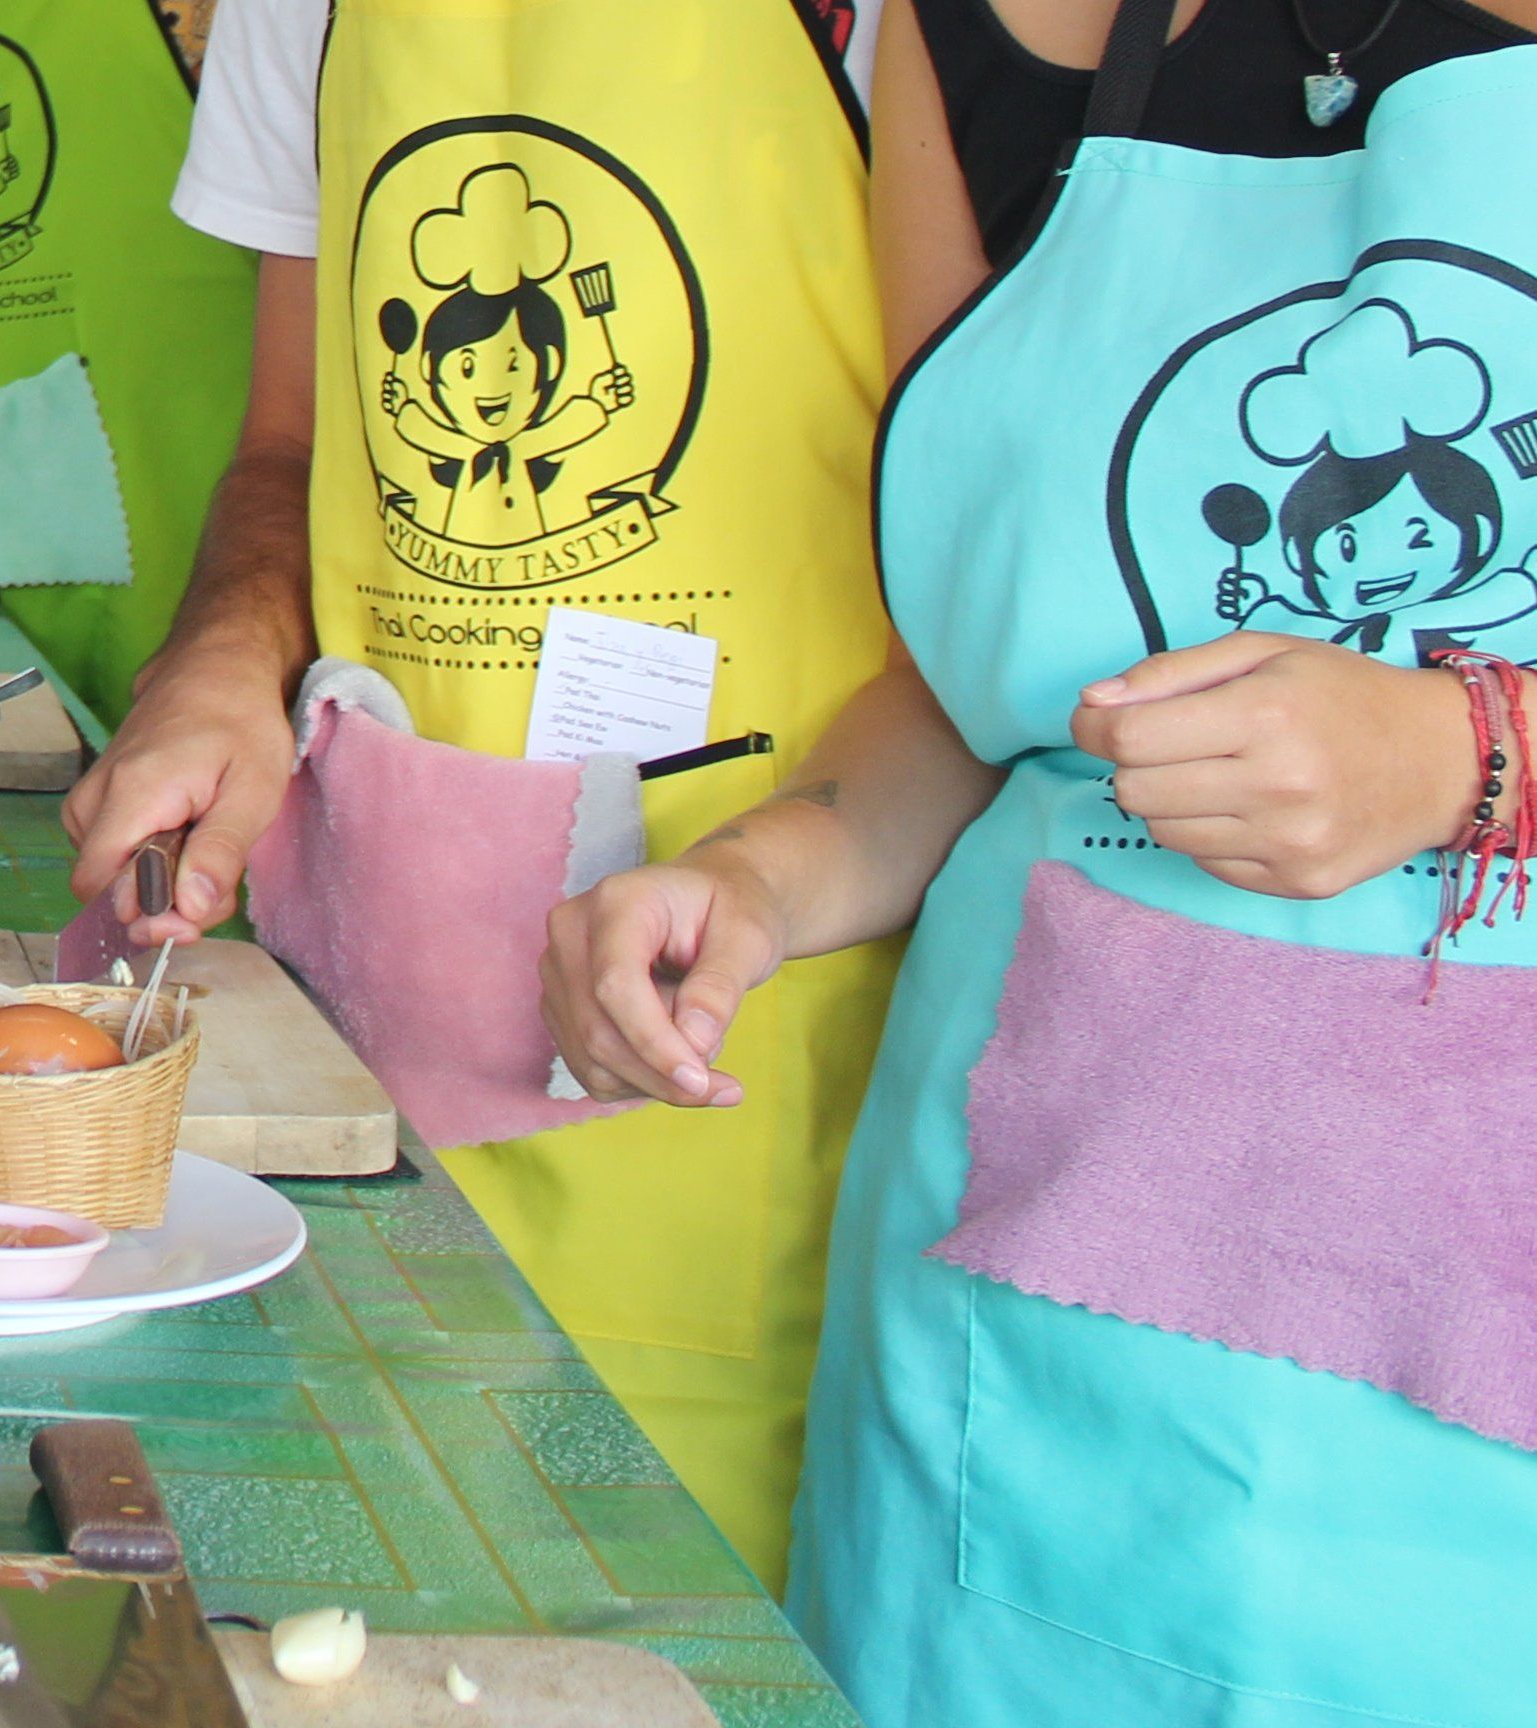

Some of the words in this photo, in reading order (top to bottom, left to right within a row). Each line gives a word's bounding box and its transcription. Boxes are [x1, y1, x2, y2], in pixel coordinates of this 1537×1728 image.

[394, 521, 504, 584] YUMMY
[517, 519, 626, 586] TASTY
[369, 606, 404, 638] Thai
[409, 613, 543, 652] Cooking
